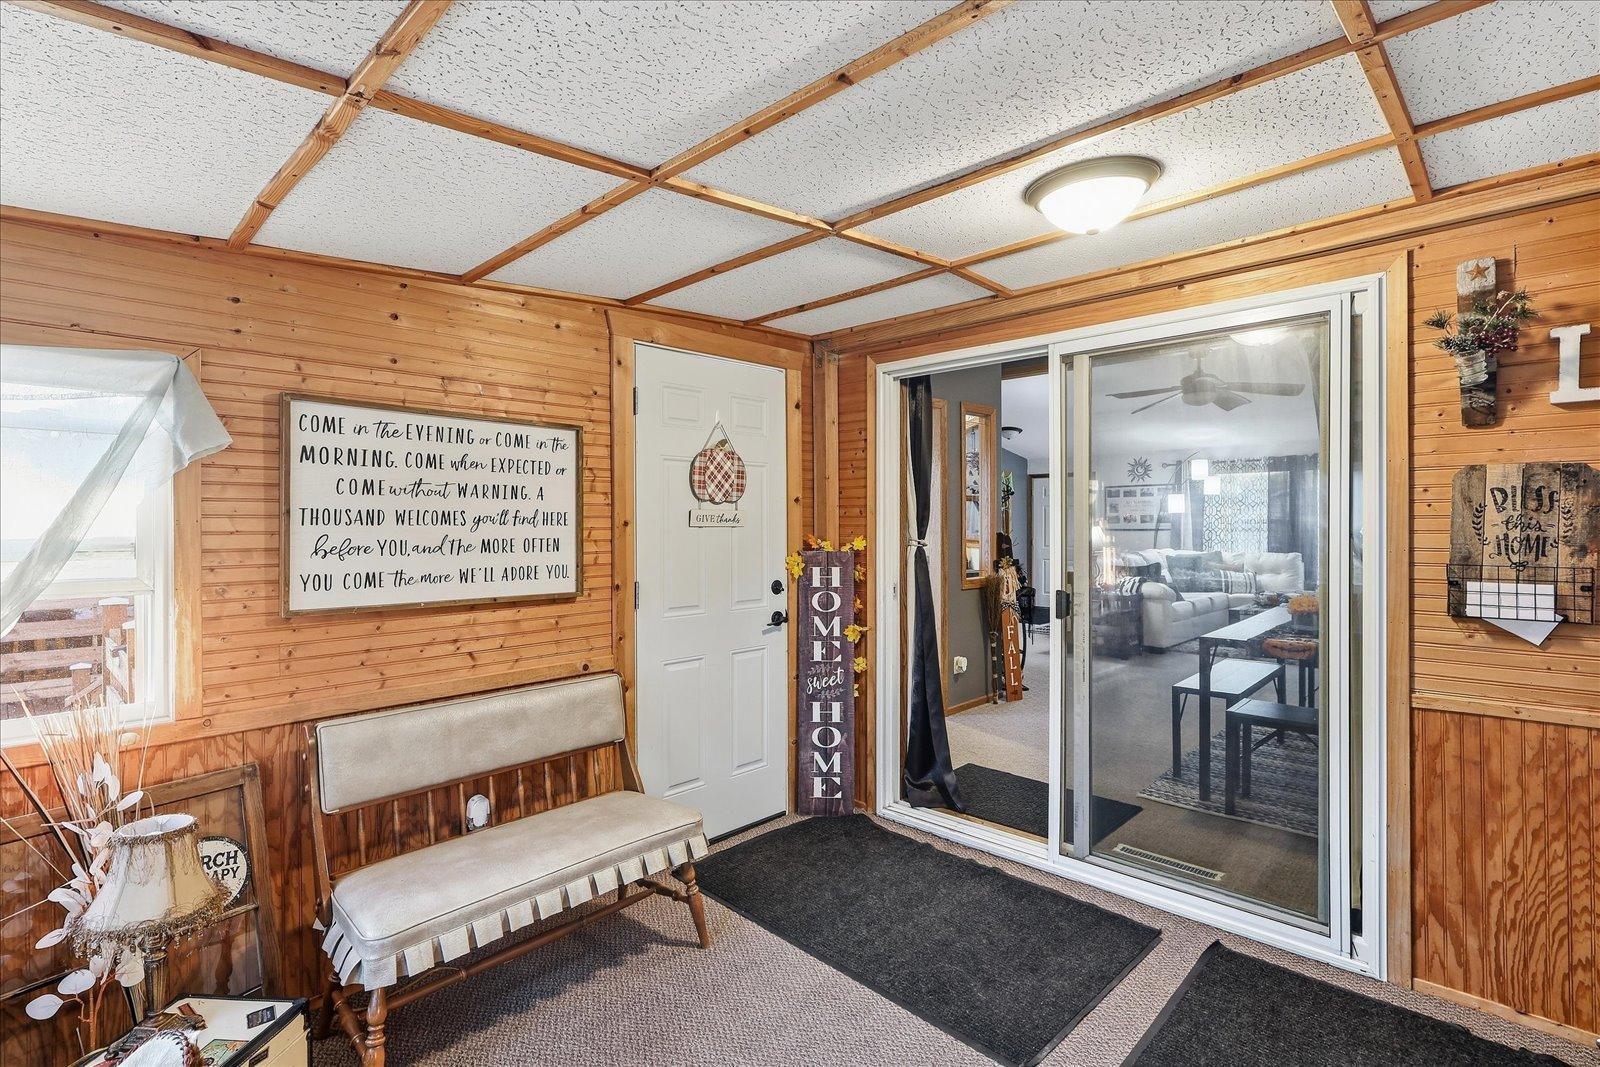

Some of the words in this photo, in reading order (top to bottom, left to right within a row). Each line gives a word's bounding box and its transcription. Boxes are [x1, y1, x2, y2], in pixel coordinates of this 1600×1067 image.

[299, 414, 346, 434] COME
[353, 423, 369, 435] in
[373, 420, 403, 439] the
[406, 424, 474, 444] EVENING
[479, 435, 492, 444] or
[496, 432, 530, 449] COME
[536, 437, 550, 450] in
[550, 435, 569, 452] the
[300, 445, 398, 468] MORNING.
[405, 452, 445, 470] COME
[450, 454, 487, 472] when
[491, 457, 550, 475] EXPECTED
[555, 466, 567, 475] or
[336, 478, 385, 495] COME
[389, 478, 455, 499] without
[457, 483, 531, 500] WARNING.
[537, 487, 544, 500] A
[1489, 484, 1559, 514] BLSS
[299, 508, 385, 526] THOUSAND
[395, 510, 467, 526] WELCOMES
[470, 509, 509, 533] you'll
[512, 509, 539, 526] find
[542, 511, 569, 526] HERE
[696, 514, 715, 523] GIVE
[716, 513, 741, 524] thanks
[1501, 514, 1547, 533] this
[310, 534, 374, 560] before
[377, 539, 410, 557] YOU,
[412, 535, 448, 555] and
[481, 538, 515, 553] MORE
[523, 537, 560, 553] OFTEN
[300, 573, 332, 591] YOU
[343, 571, 384, 589] COME
[388, 570, 420, 587] the
[420, 572, 454, 584] more
[459, 568, 495, 584] WE'LL
[501, 564, 539, 581] ADORE
[546, 564, 569, 579] YOU.
[810, 566, 843, 662] HOME
[1006, 625, 1018, 686] FALL
[806, 667, 845, 694] sweet
[810, 701, 843, 799] HOME
[200, 850, 239, 870] RCH
[206, 866, 240, 881] APY
